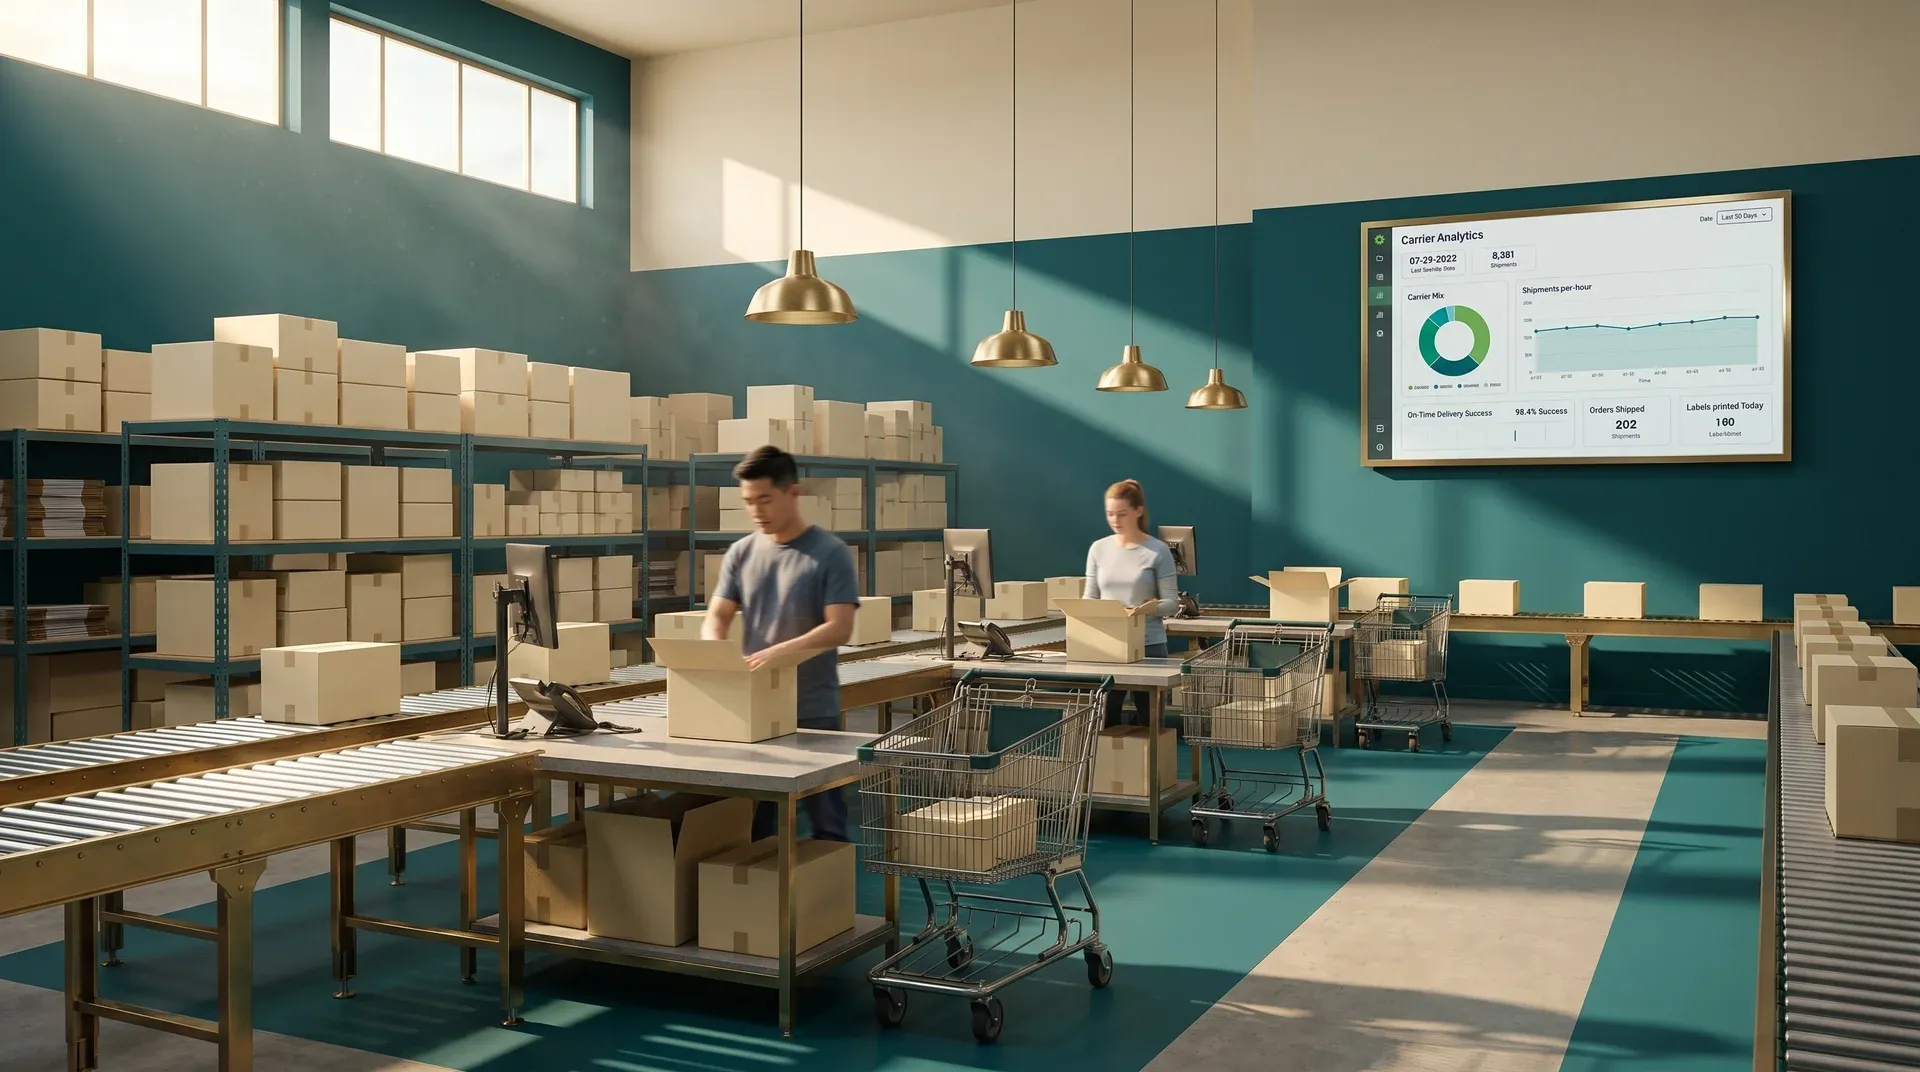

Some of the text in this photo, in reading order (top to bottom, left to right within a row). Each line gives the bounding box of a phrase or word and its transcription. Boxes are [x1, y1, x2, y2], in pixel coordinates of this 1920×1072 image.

[1401, 230, 1484, 245] Carrier Analytics
[1409, 254, 1457, 265] 07-29-2022
[1492, 250, 1515, 260] 8,381
[1490, 261, 1517, 269] Shipments
[1522, 284, 1592, 295] Shipments per-hour
[1407, 292, 1444, 301] Carrier Mix
[1515, 407, 1568, 416] 98.4% Success
[1589, 405, 1645, 414] Orders Shipped
[1686, 401, 1764, 412] Labels printed Today
[1407, 409, 1493, 419] On-Time Delivery Success
[1615, 419, 1637, 430] 202
